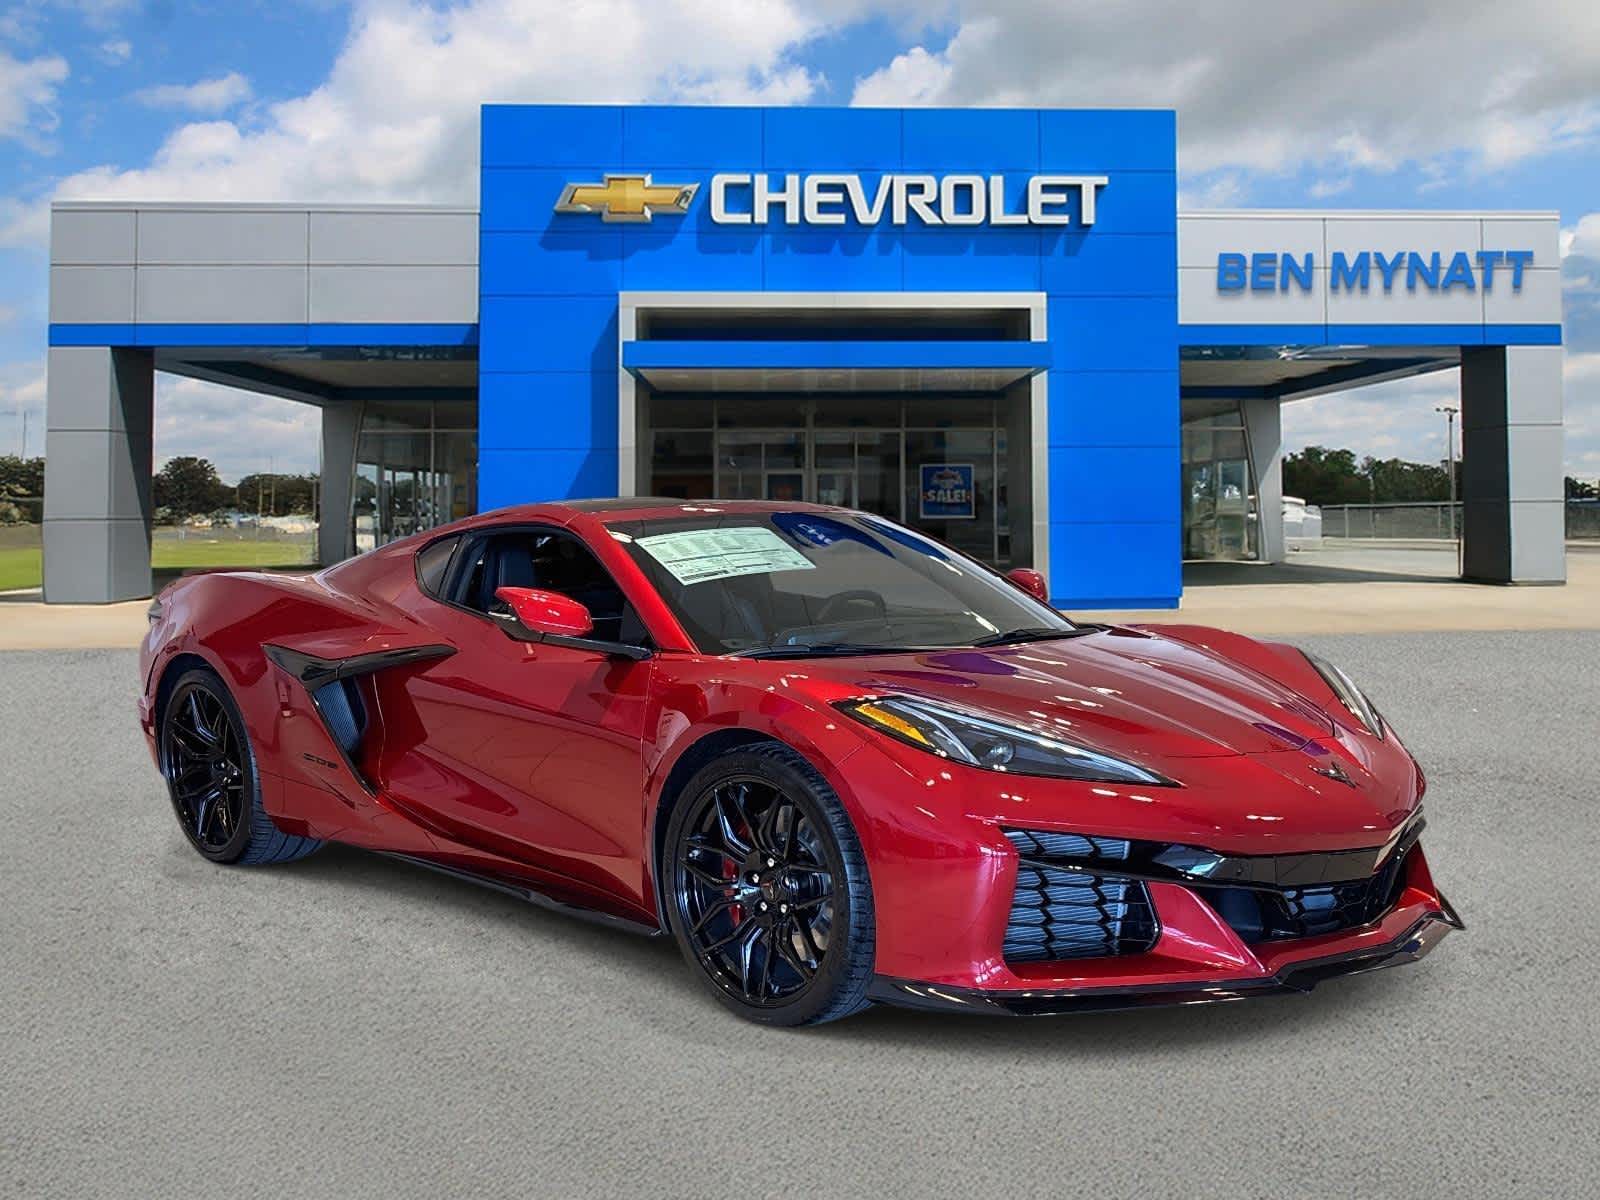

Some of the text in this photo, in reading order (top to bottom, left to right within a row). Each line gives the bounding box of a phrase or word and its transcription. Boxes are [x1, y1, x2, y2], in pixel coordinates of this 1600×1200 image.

[709, 173, 1109, 226] CHEVROLET
[1217, 250, 1534, 291] BEN MYNATT
